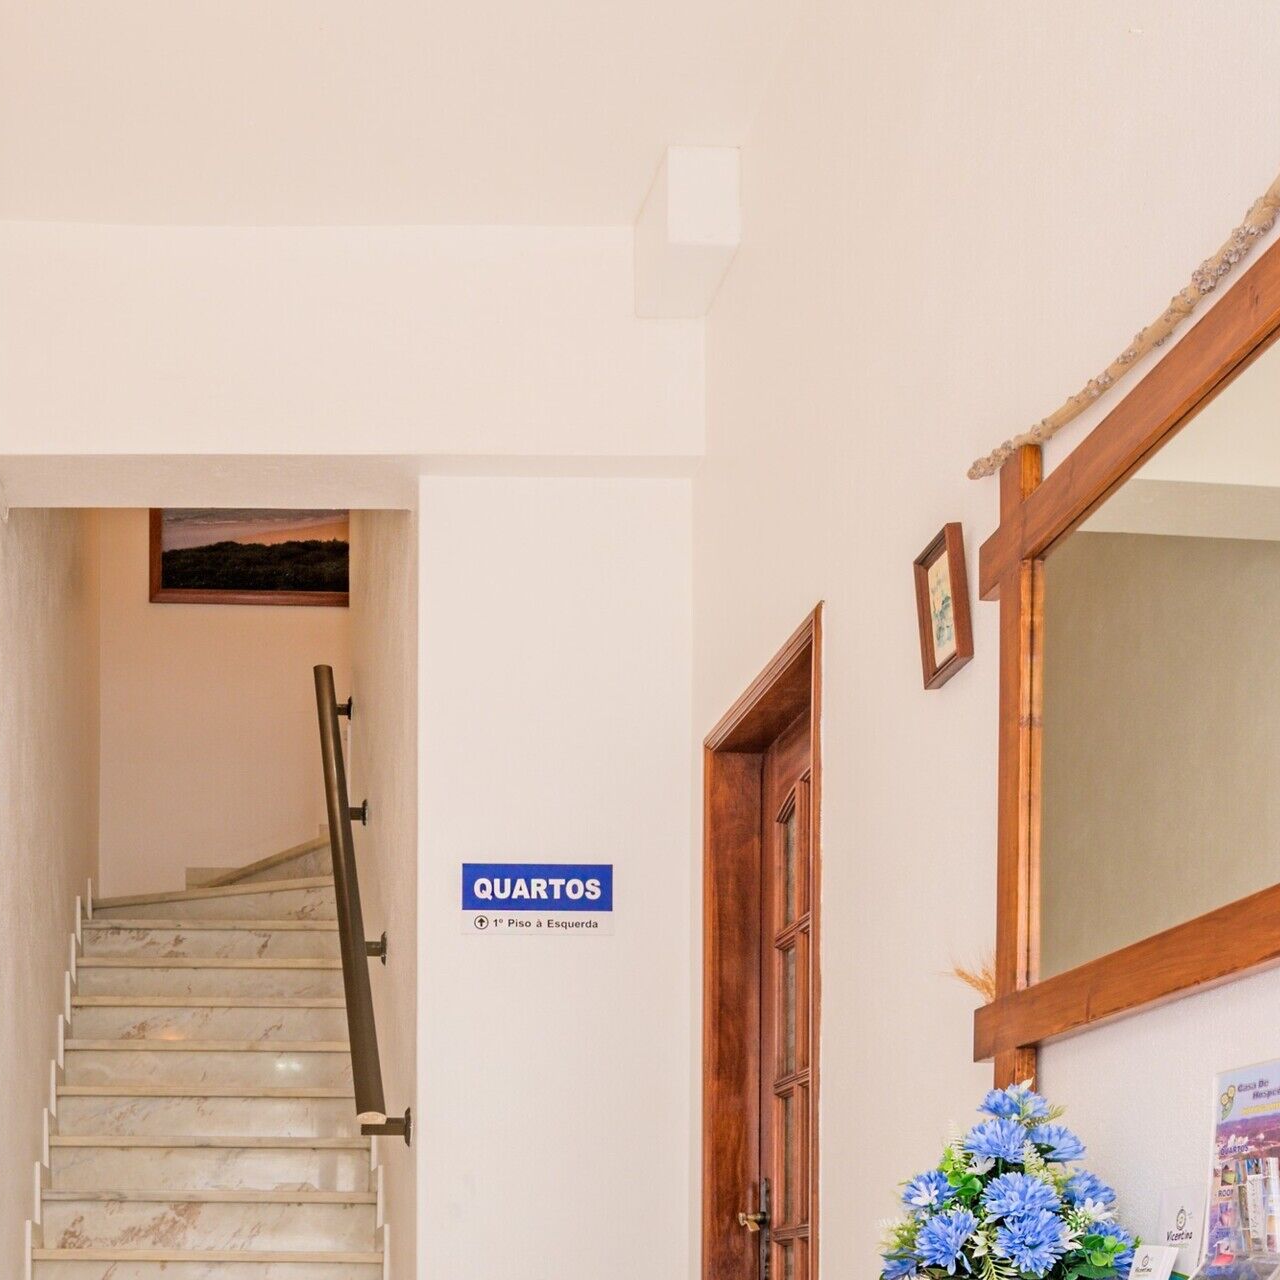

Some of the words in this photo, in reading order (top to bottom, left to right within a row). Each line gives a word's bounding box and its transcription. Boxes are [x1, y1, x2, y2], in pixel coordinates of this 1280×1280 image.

[473, 877, 602, 901] QUARTOS
[492, 918, 504, 928] 1º
[507, 918, 532, 928] Piso
[536, 918, 542, 928] à
[546, 919, 599, 930] Esquerda
[1237, 1082, 1257, 1092] Casa
[1258, 1080, 1269, 1088] De
[1220, 1144, 1249, 1156] QUARTOS
